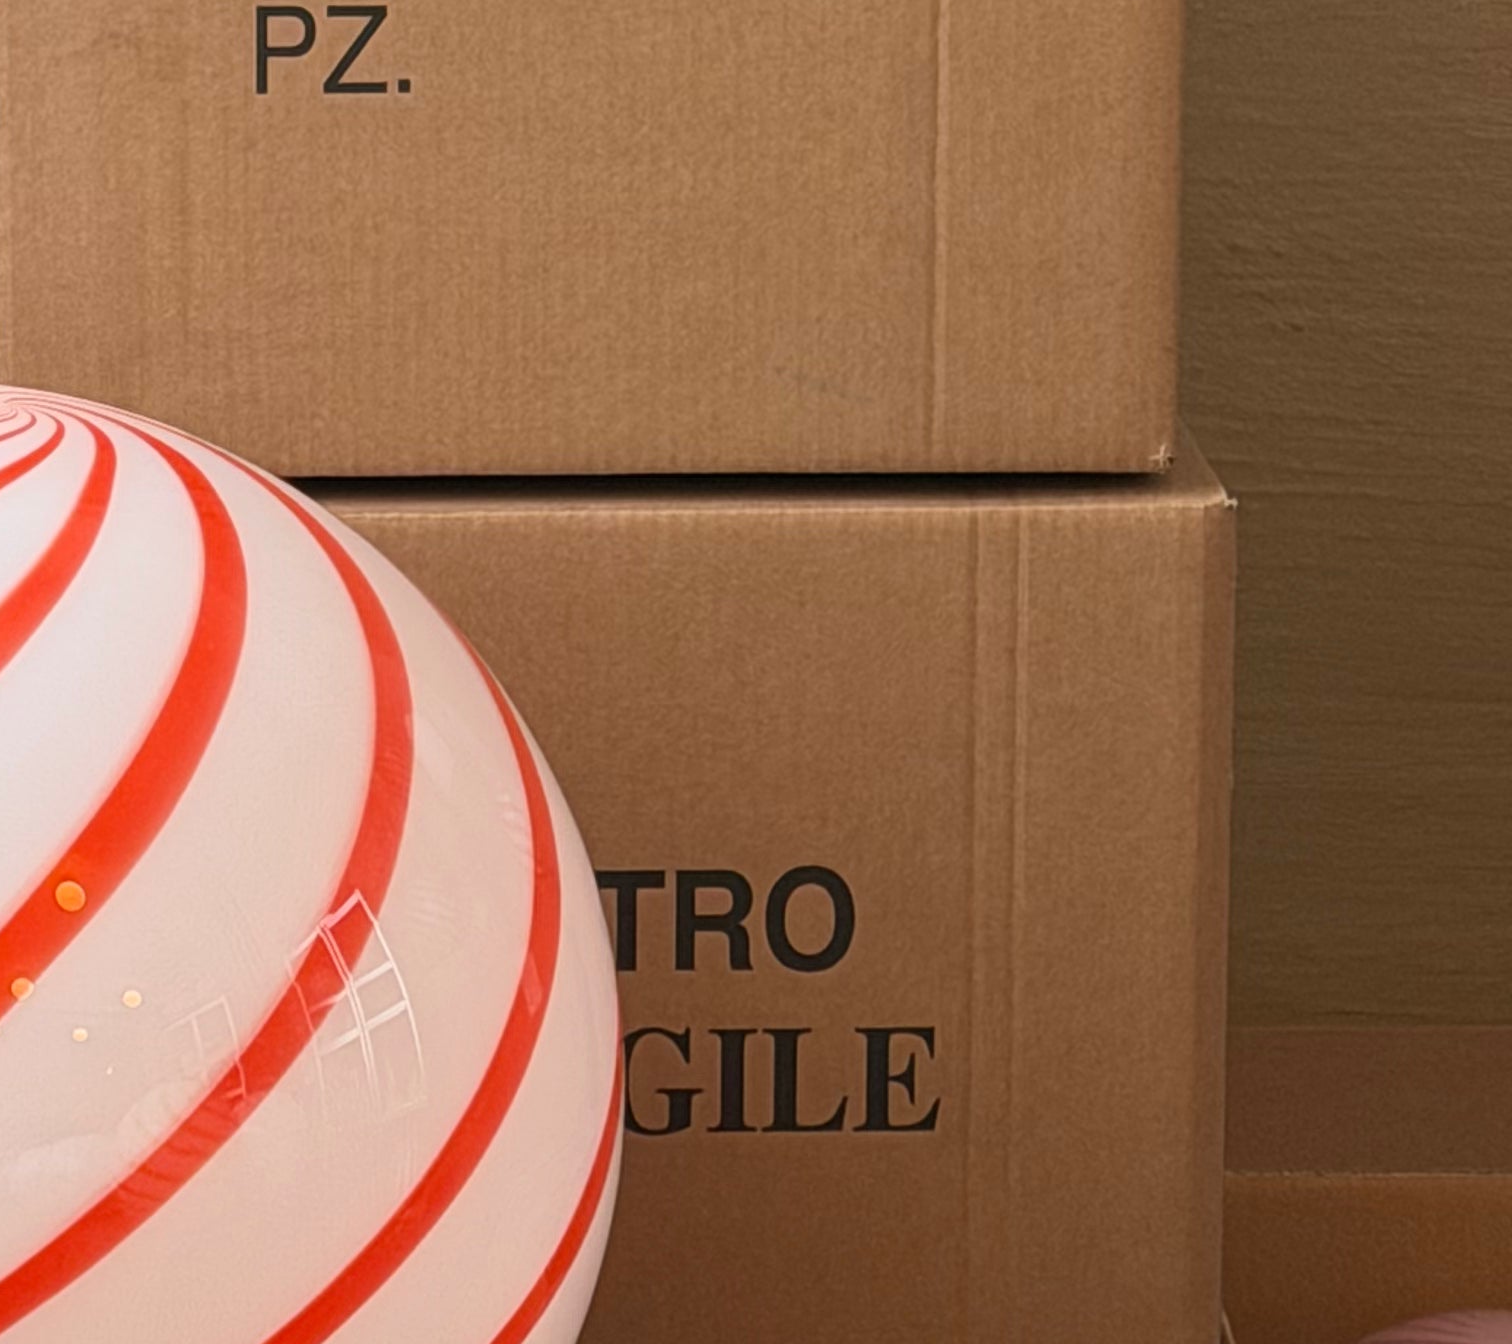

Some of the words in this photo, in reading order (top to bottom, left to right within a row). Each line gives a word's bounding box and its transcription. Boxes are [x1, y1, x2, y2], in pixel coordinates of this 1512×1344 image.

[255, 4, 411, 94] PZ.
[594, 864, 856, 973] TRO
[623, 1026, 941, 1137] GILE
